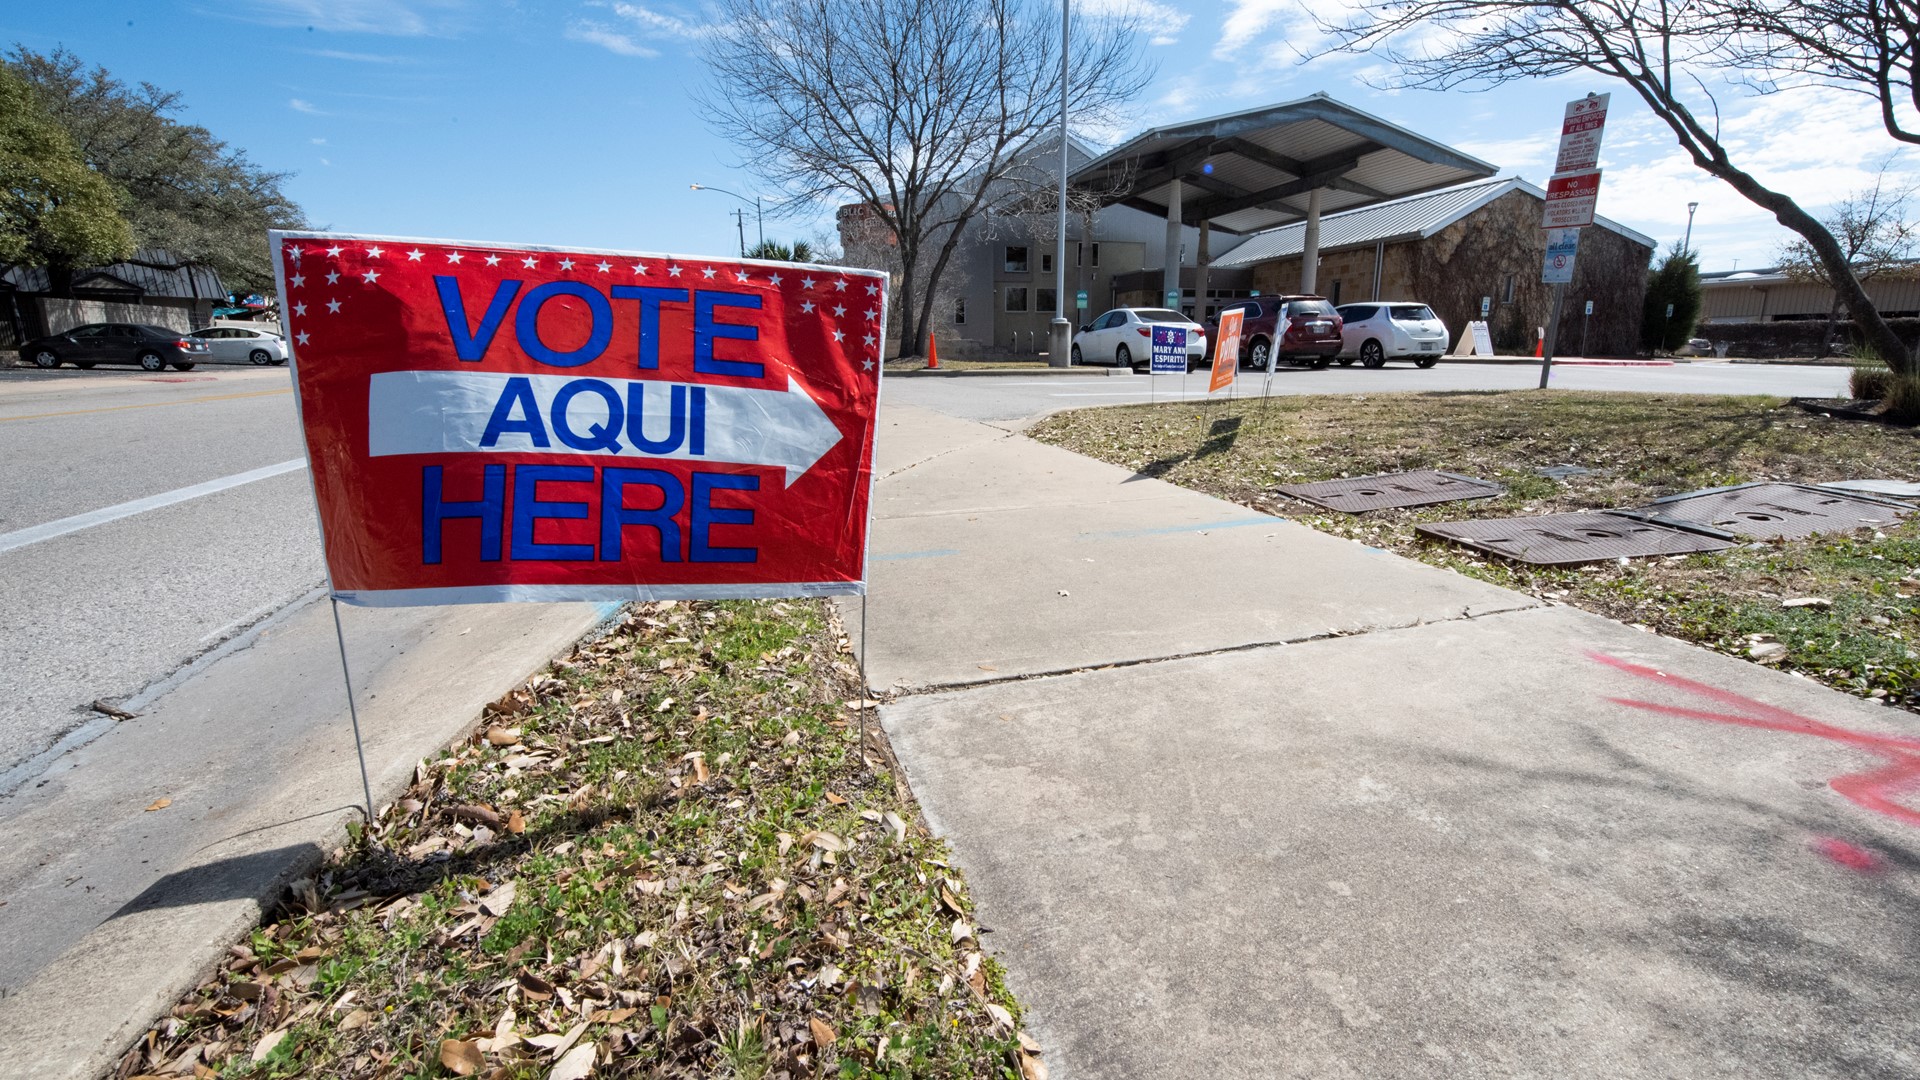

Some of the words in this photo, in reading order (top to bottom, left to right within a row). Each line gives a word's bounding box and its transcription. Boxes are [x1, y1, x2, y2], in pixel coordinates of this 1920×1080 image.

[1582, 110, 1606, 122] ENFORCED
[1584, 120, 1598, 130] TIMES
[1547, 187, 1596, 200] TRESPASSING
[1547, 208, 1571, 217] VIOLATORS
[433, 275, 765, 379] VOTE
[1154, 346, 1172, 354] MARY
[1155, 355, 1184, 363] ESPIRITU
[480, 377, 706, 455] AQUI
[421, 464, 761, 566] HERE
